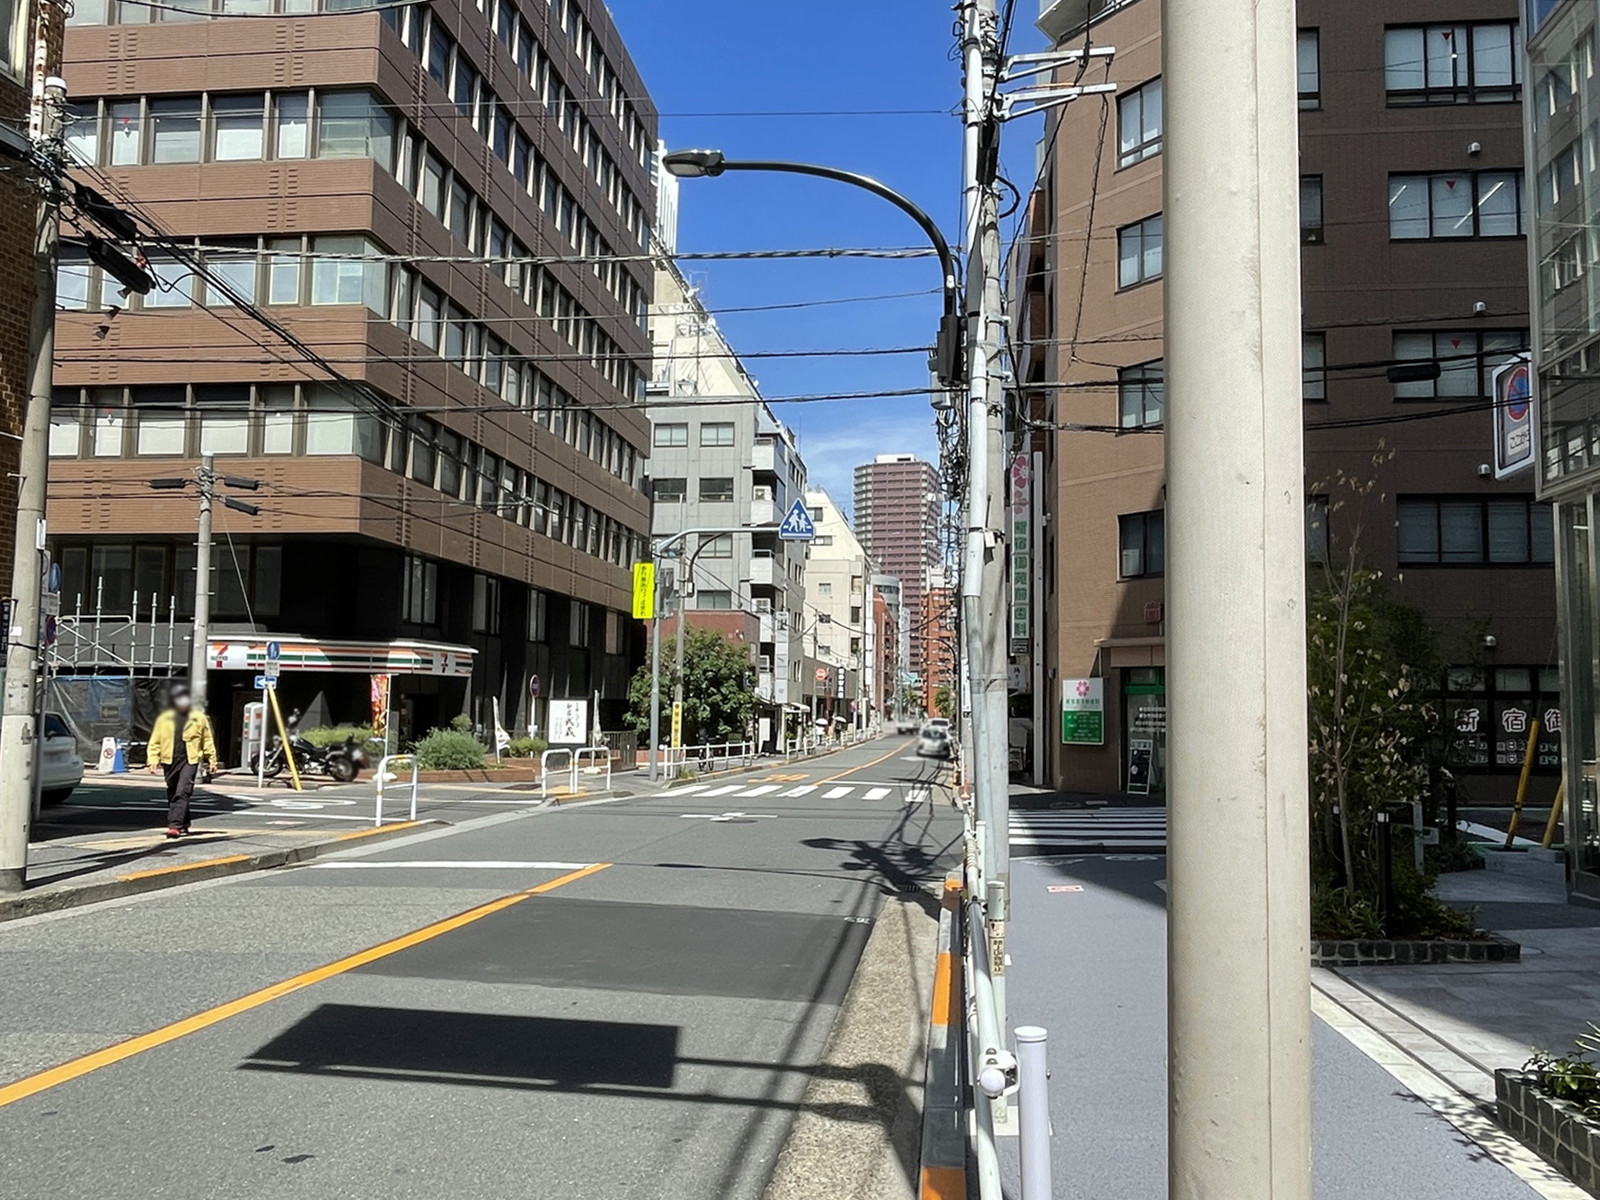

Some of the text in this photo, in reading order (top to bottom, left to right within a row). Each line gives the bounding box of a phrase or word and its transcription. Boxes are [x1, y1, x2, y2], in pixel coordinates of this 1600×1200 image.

[1014, 521, 1027, 636] 新宿御苑前歯科
